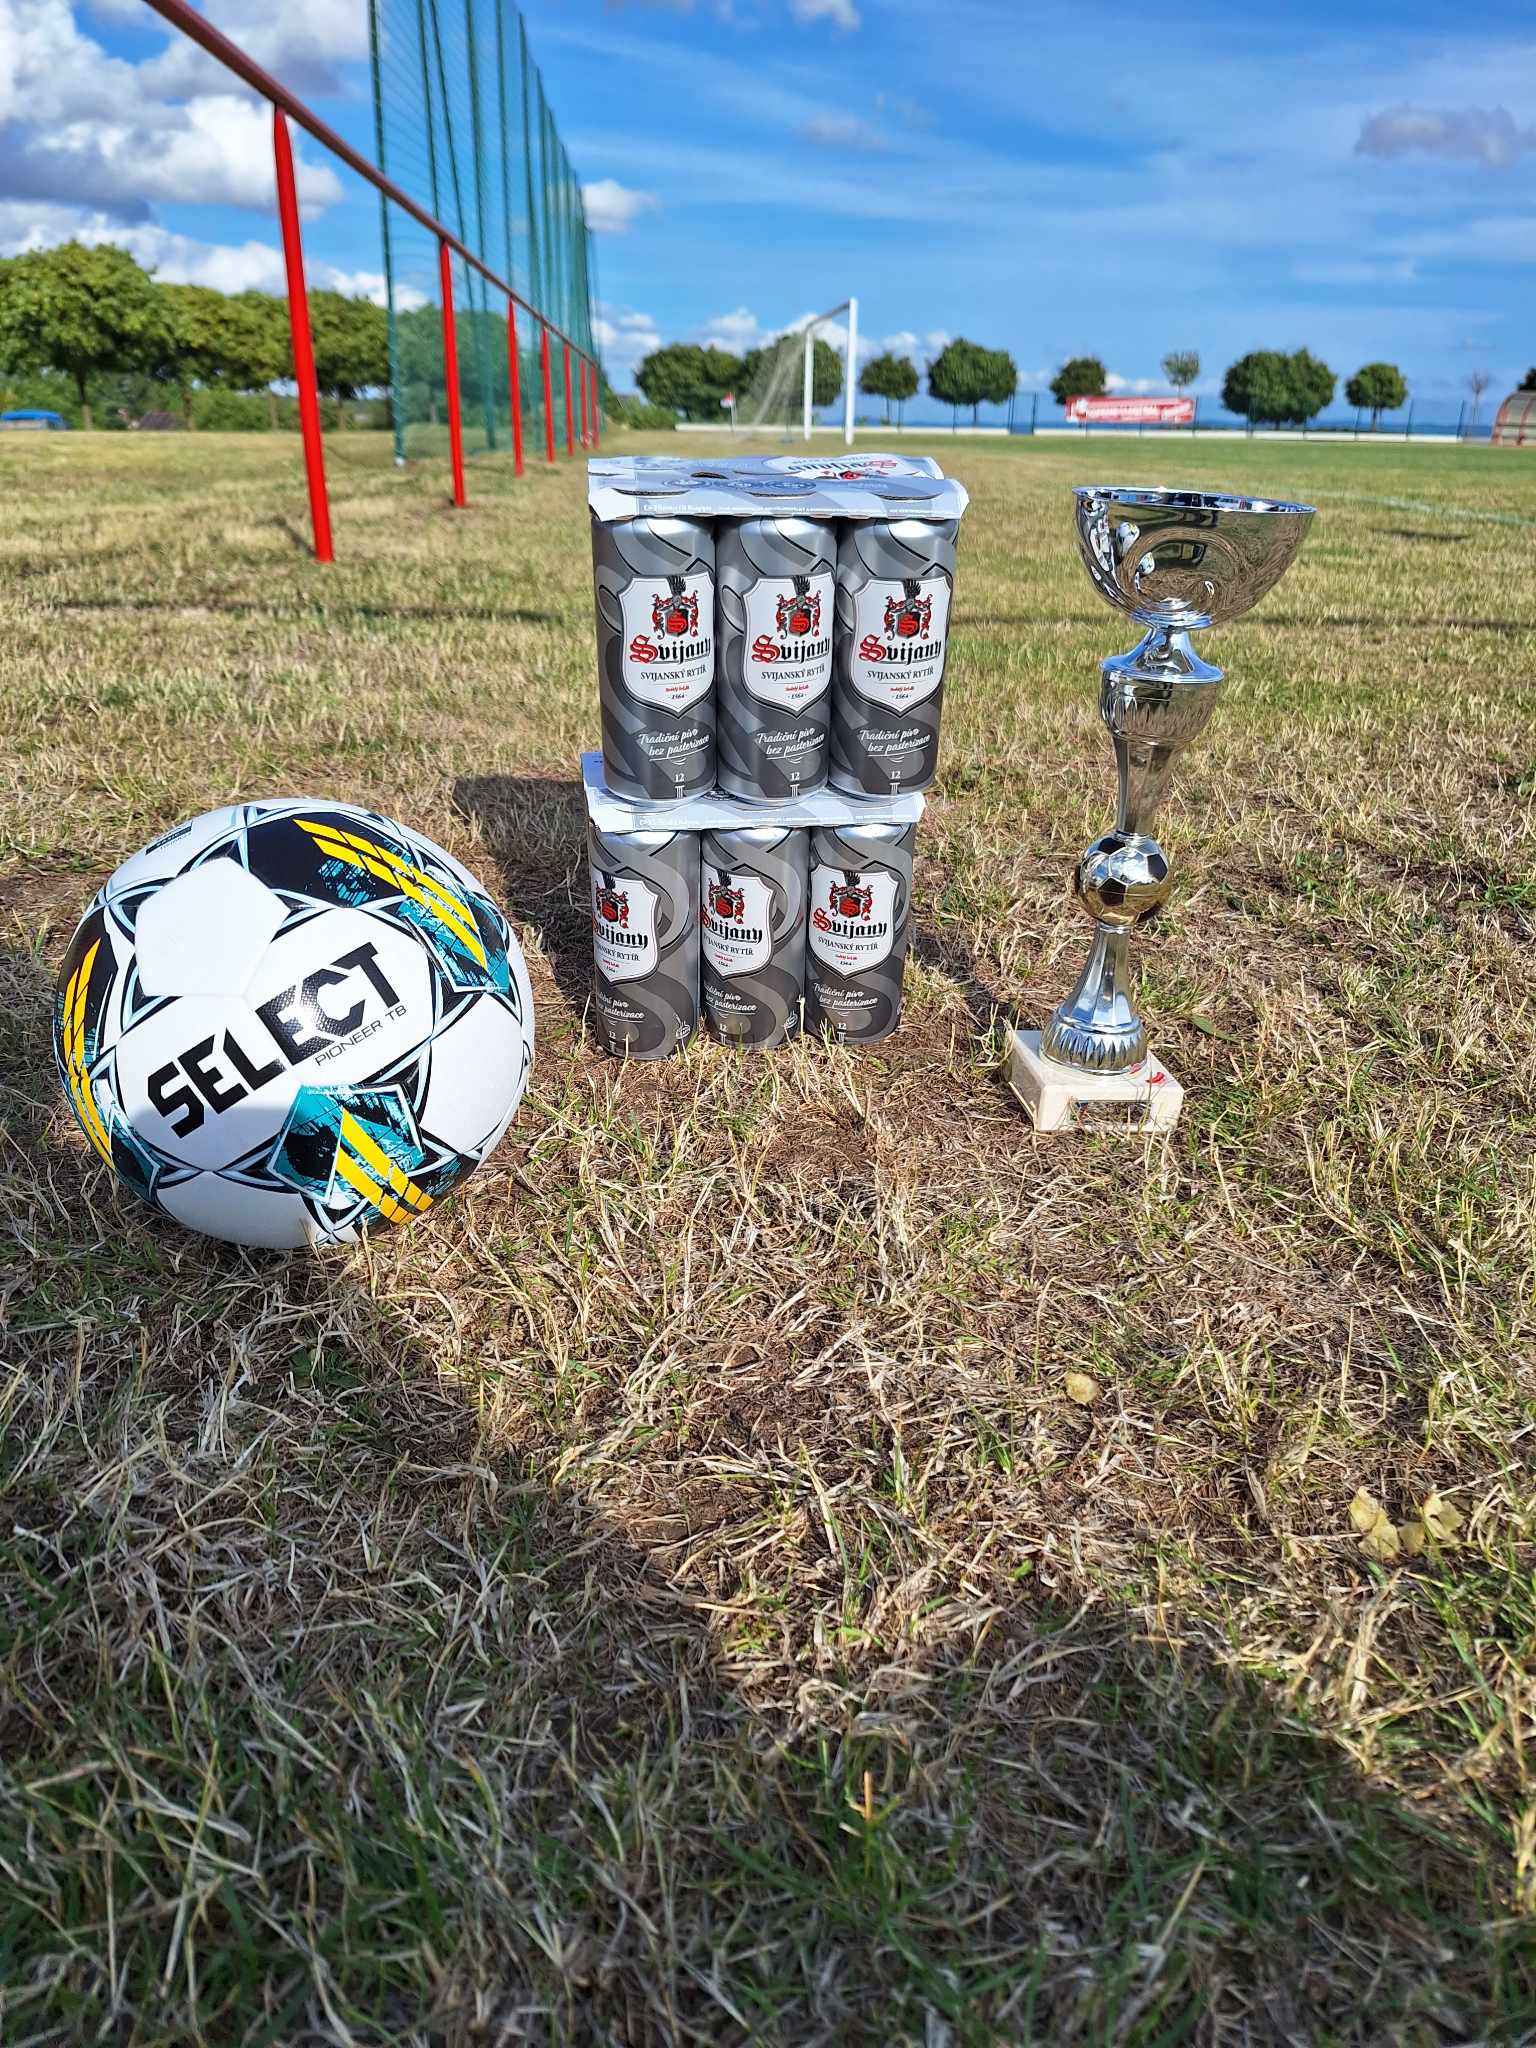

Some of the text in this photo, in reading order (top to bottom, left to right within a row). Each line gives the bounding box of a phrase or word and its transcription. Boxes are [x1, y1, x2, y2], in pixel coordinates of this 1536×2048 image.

[630, 634, 711, 664] Svijany
[751, 634, 830, 664] Svijany
[859, 634, 942, 665] Svijany
[640, 668, 686, 681] SVIJANSKÝ
[761, 668, 806, 681] SVIJANSKÝ
[866, 669, 912, 681] SVIJANSKÝ
[638, 728, 698, 745] Tradiční pivo
[757, 727, 815, 743] Tradiční pivo
[859, 728, 920, 742] Tradiční pivo
[648, 746, 665, 756] bez
[766, 744, 782, 754] bez
[867, 742, 884, 752] bez
[674, 772, 685, 782] 12
[790, 771, 800, 781] 12
[891, 770, 901, 780] 12
[813, 907, 888, 939] Svijany
[730, 946, 754, 956] RYTÍŘ
[855, 943, 879, 951] RYTÍŘ
[813, 982, 865, 1000] Tradiční pivo
[724, 993, 742, 1002] pivo
[612, 1000, 630, 1009] pivo
[720, 1024, 728, 1032] 12
[837, 1022, 847, 1030] 12
[148, 941, 400, 1139] SELECT
[314, 1004, 407, 1067] PIONEER TB
[609, 1031, 617, 1039] 12
